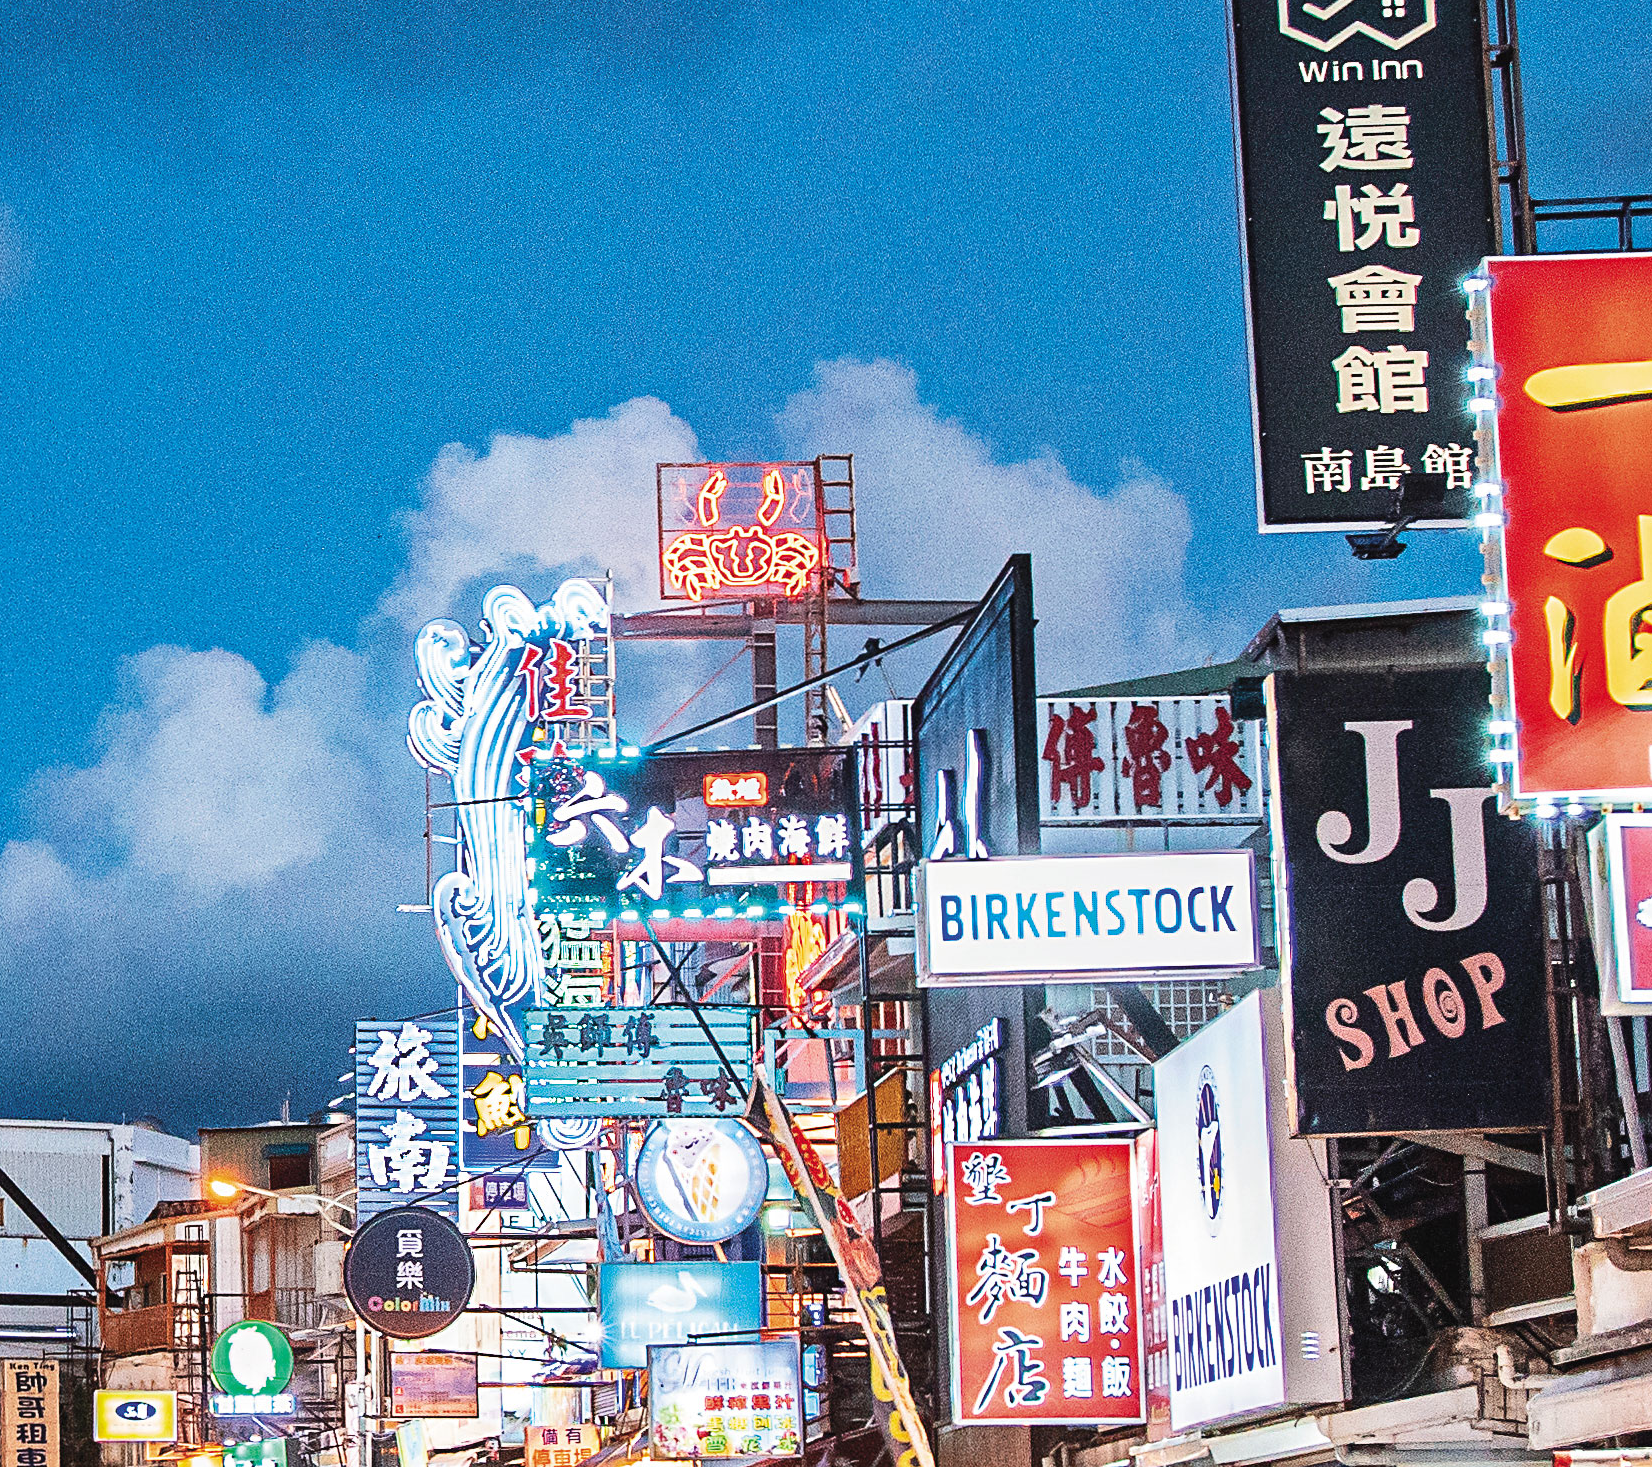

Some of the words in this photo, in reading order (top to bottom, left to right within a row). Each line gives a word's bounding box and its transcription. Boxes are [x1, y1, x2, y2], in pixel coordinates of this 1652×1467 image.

[1321, 102, 1432, 412] 遠悅會館
[706, 813, 850, 863] 燒肉海鮮
[1316, 719, 1501, 929] JJ
[940, 884, 1237, 943] BIRKENSTOCK
[1320, 944, 1520, 1067] SHOP
[395, 1228, 424, 1290] 覓樂
[961, 1151, 1058, 1415] 墾丁麵店
[1058, 1246, 1094, 1400] 牛肉麵
[1172, 1261, 1277, 1393] BIRKENSTOCK
[540, 1426, 582, 1446] 備有
